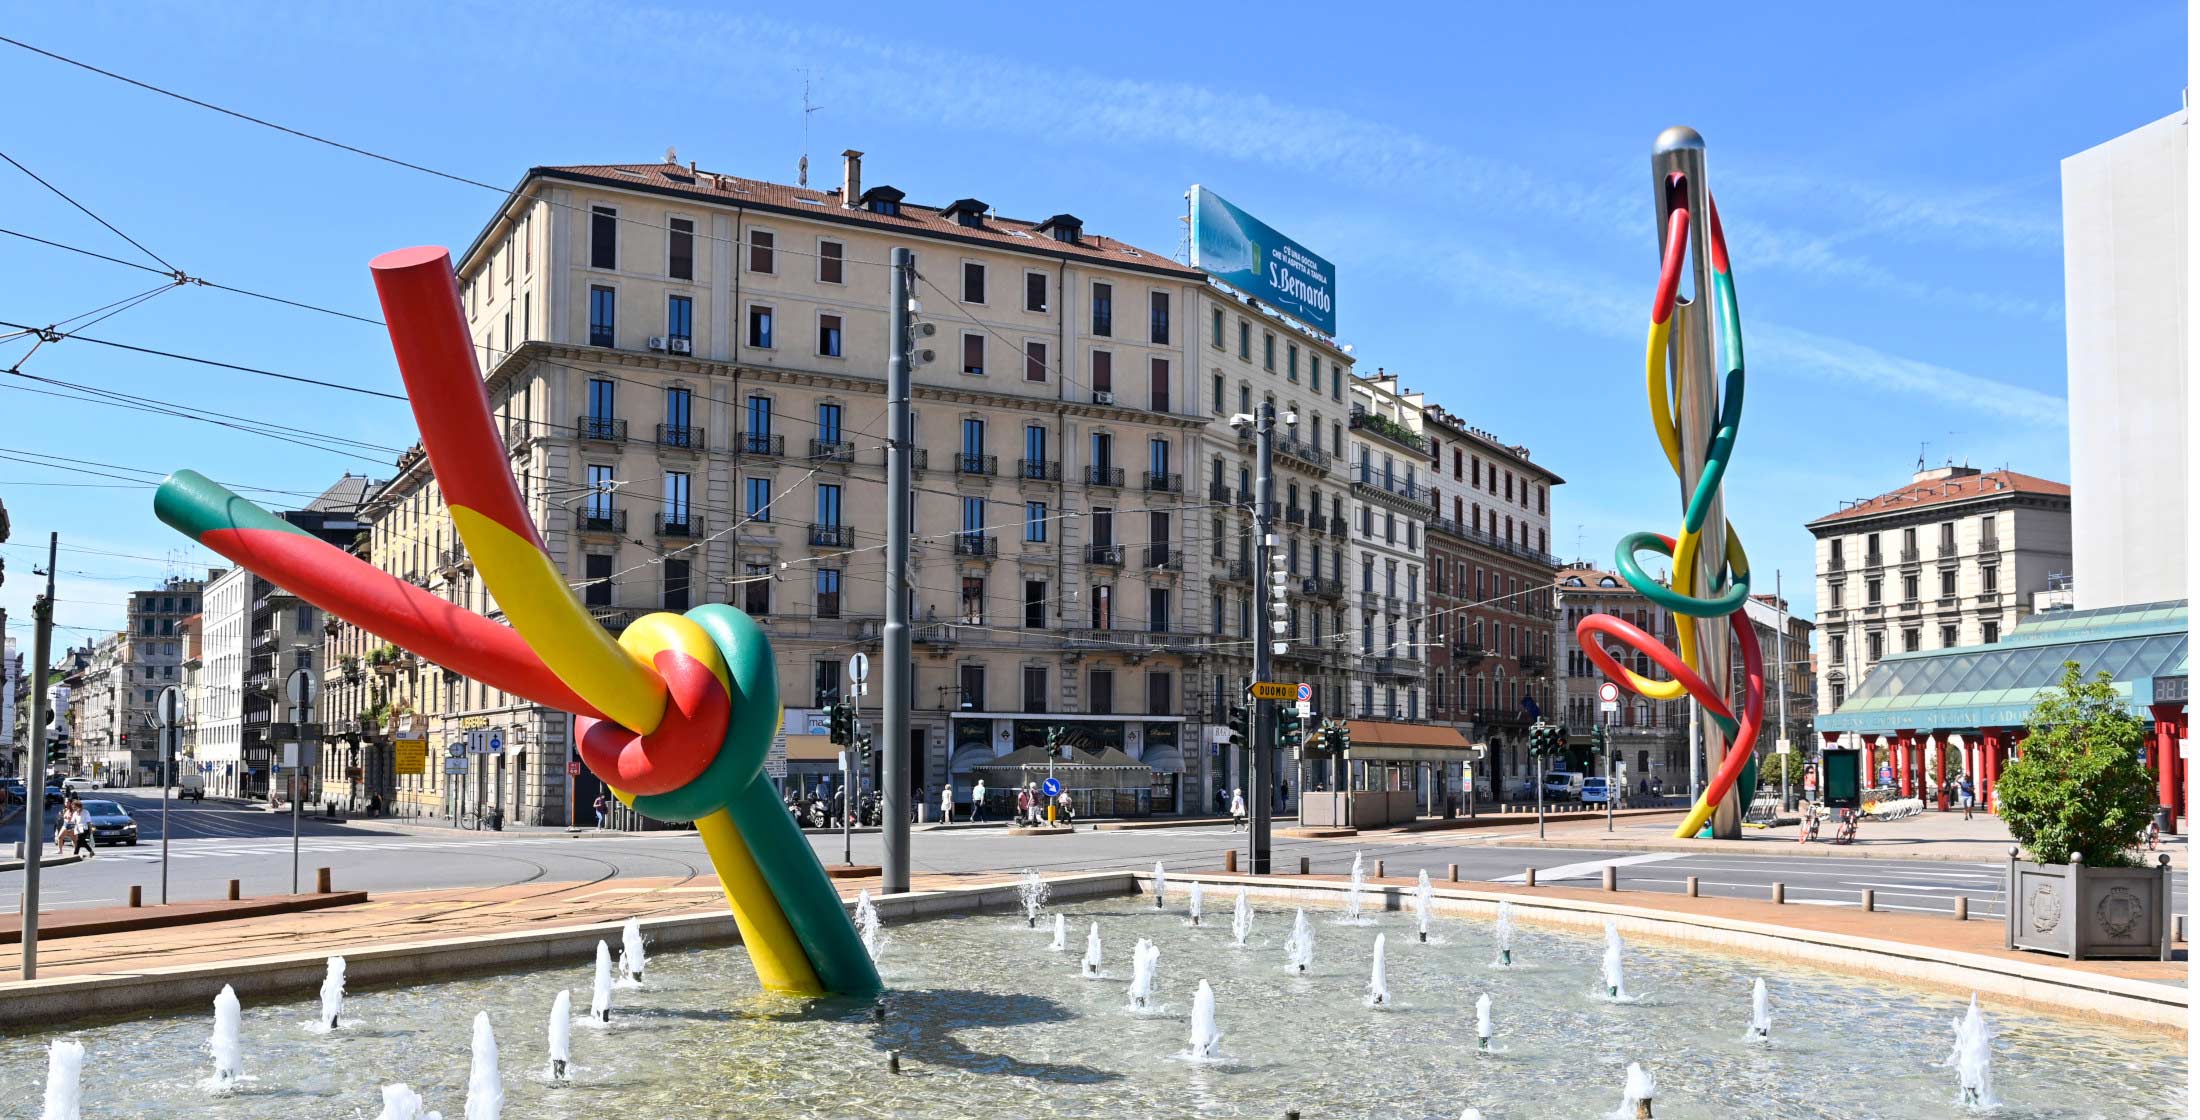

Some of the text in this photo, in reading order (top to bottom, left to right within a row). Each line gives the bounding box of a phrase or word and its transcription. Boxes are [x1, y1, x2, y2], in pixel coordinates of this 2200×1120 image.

[1272, 248, 1282, 261] CHE
[1287, 257, 1307, 275] ASPETTA
[1301, 255, 1318, 271] GOCCIA
[1269, 261, 1330, 313] S.Bernardo
[1260, 685, 1287, 696] DUOMO
